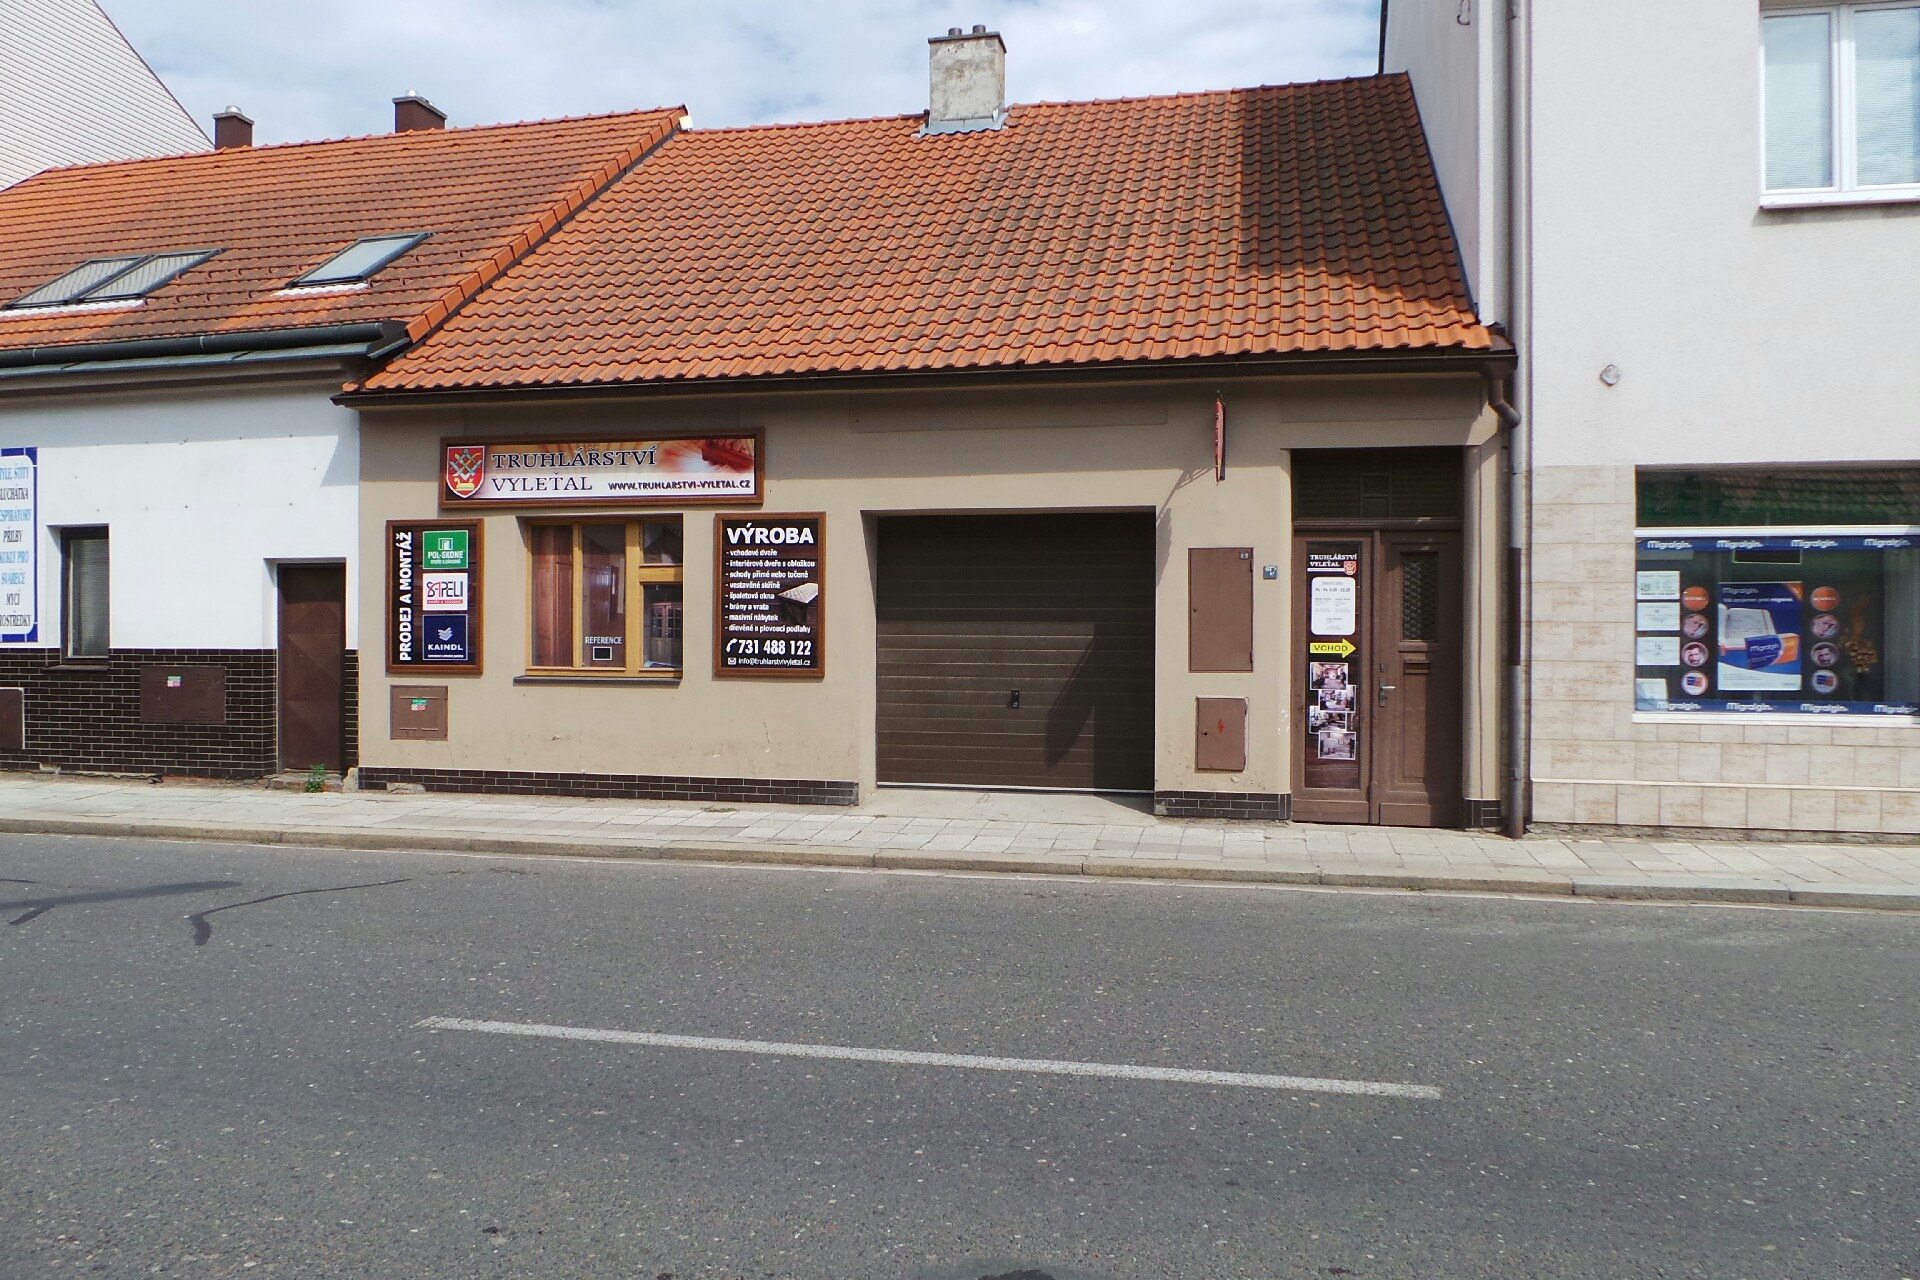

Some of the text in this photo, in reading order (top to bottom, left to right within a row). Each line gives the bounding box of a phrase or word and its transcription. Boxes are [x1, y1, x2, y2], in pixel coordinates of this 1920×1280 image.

[491, 444, 657, 469] TRUHLÁŘSTVÍ
[491, 471, 593, 491] VYLEŤAL
[607, 479, 751, 491] WWW.TRUHLARSTVI-VYLETAL.CZ
[727, 523, 814, 544] VÝROBA
[428, 551, 464, 559] POL-SKONE
[730, 571, 751, 579] schody
[427, 581, 463, 598] SAPELI
[395, 531, 412, 661] PRODEJ A MONTÁŽ
[729, 603, 747, 611] brány
[754, 613, 778, 622] nábytek
[786, 625, 811, 633] podlahy
[585, 636, 622, 644] REFERENCE
[738, 640, 812, 655] 731 488 122
